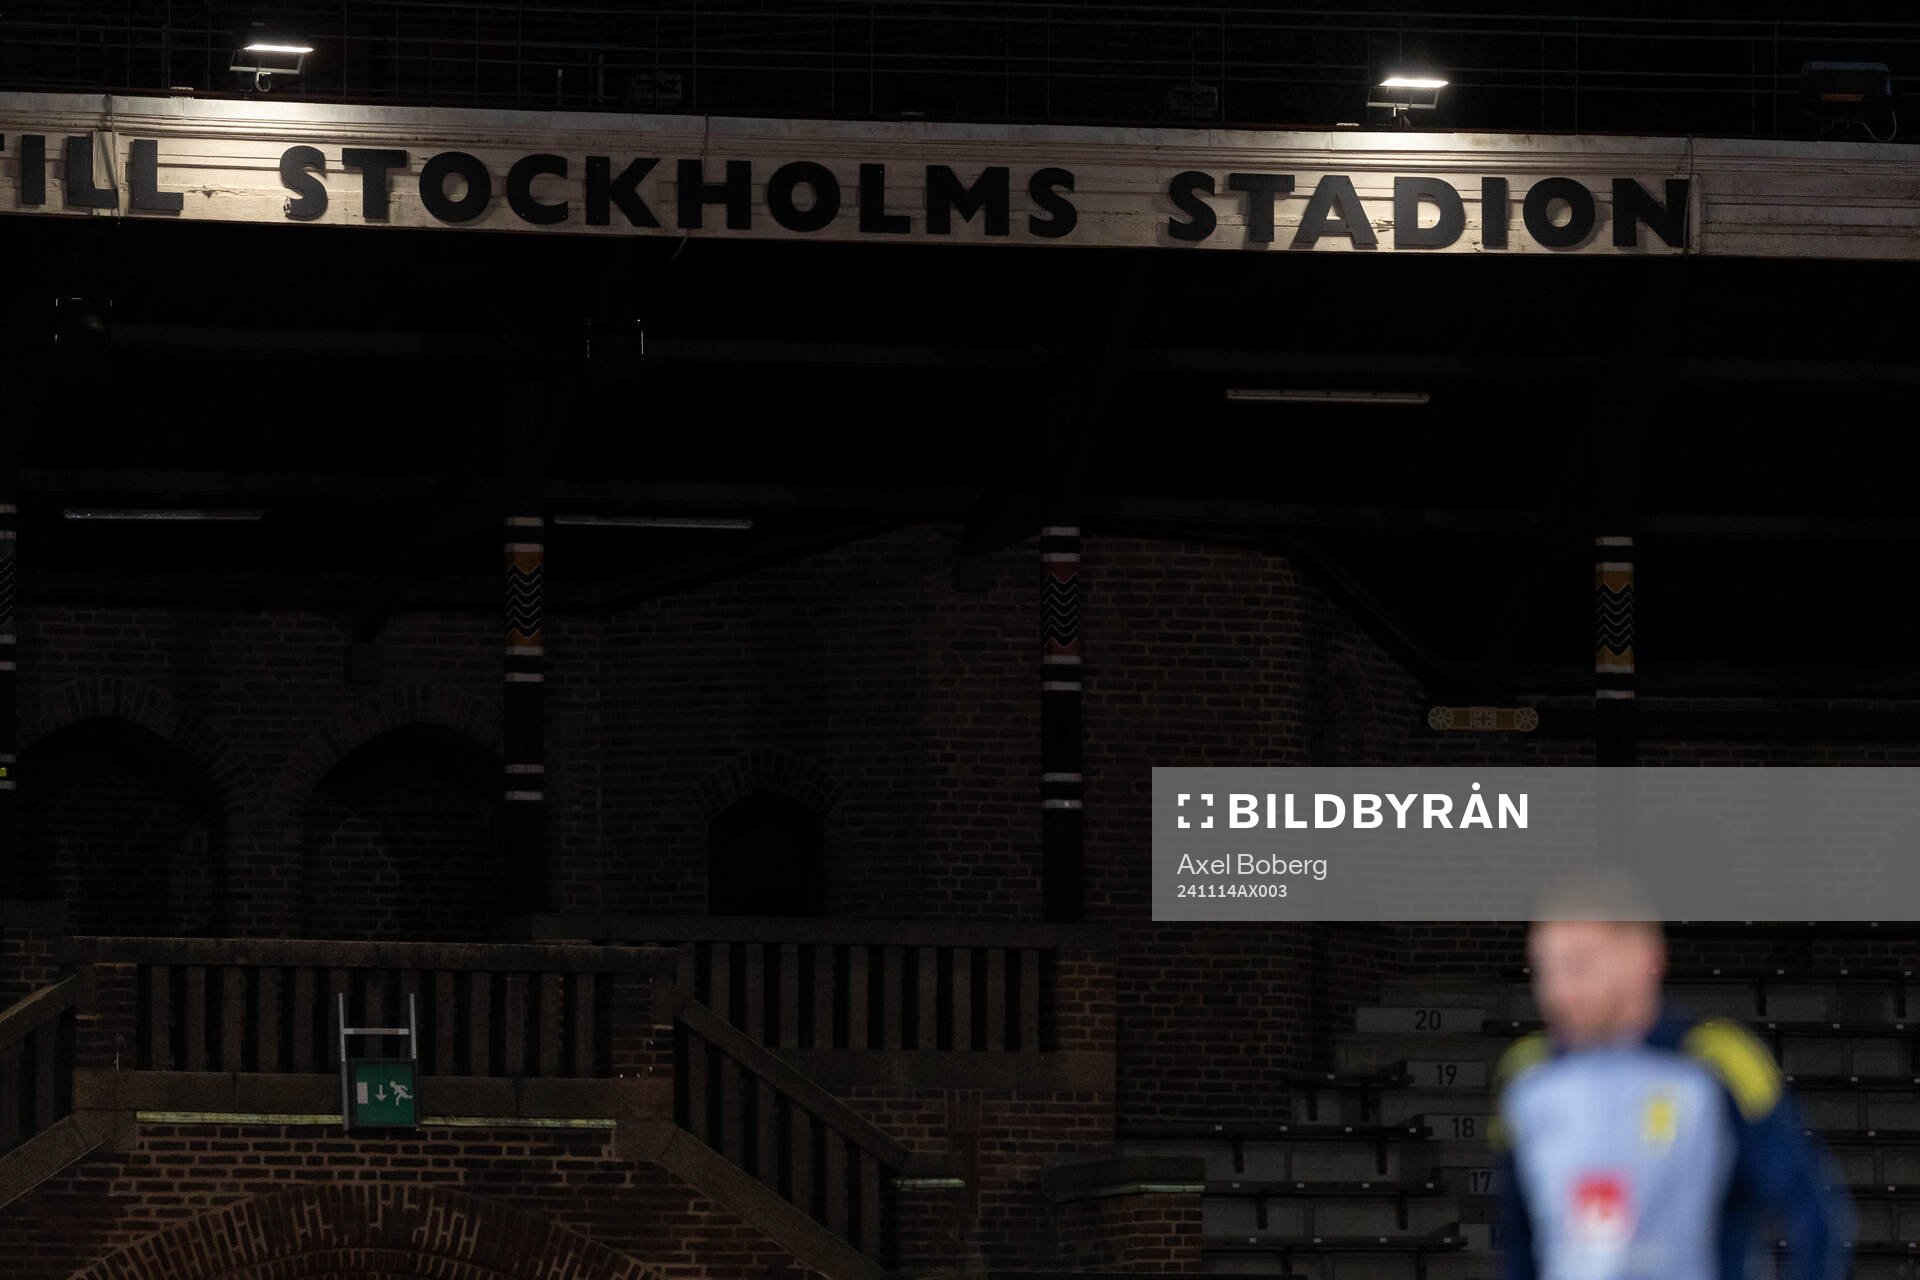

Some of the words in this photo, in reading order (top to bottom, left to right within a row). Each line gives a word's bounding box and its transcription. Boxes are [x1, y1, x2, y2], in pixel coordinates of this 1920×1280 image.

[0, 134, 184, 211] ILL
[280, 145, 1078, 238] STOCKHOLMS
[1168, 171, 1691, 250] STADION
[1414, 1009, 1442, 1031] 20
[1436, 1064, 1457, 1085] 19
[1452, 1117, 1475, 1138] 18
[1471, 1171, 1492, 1192] 17
